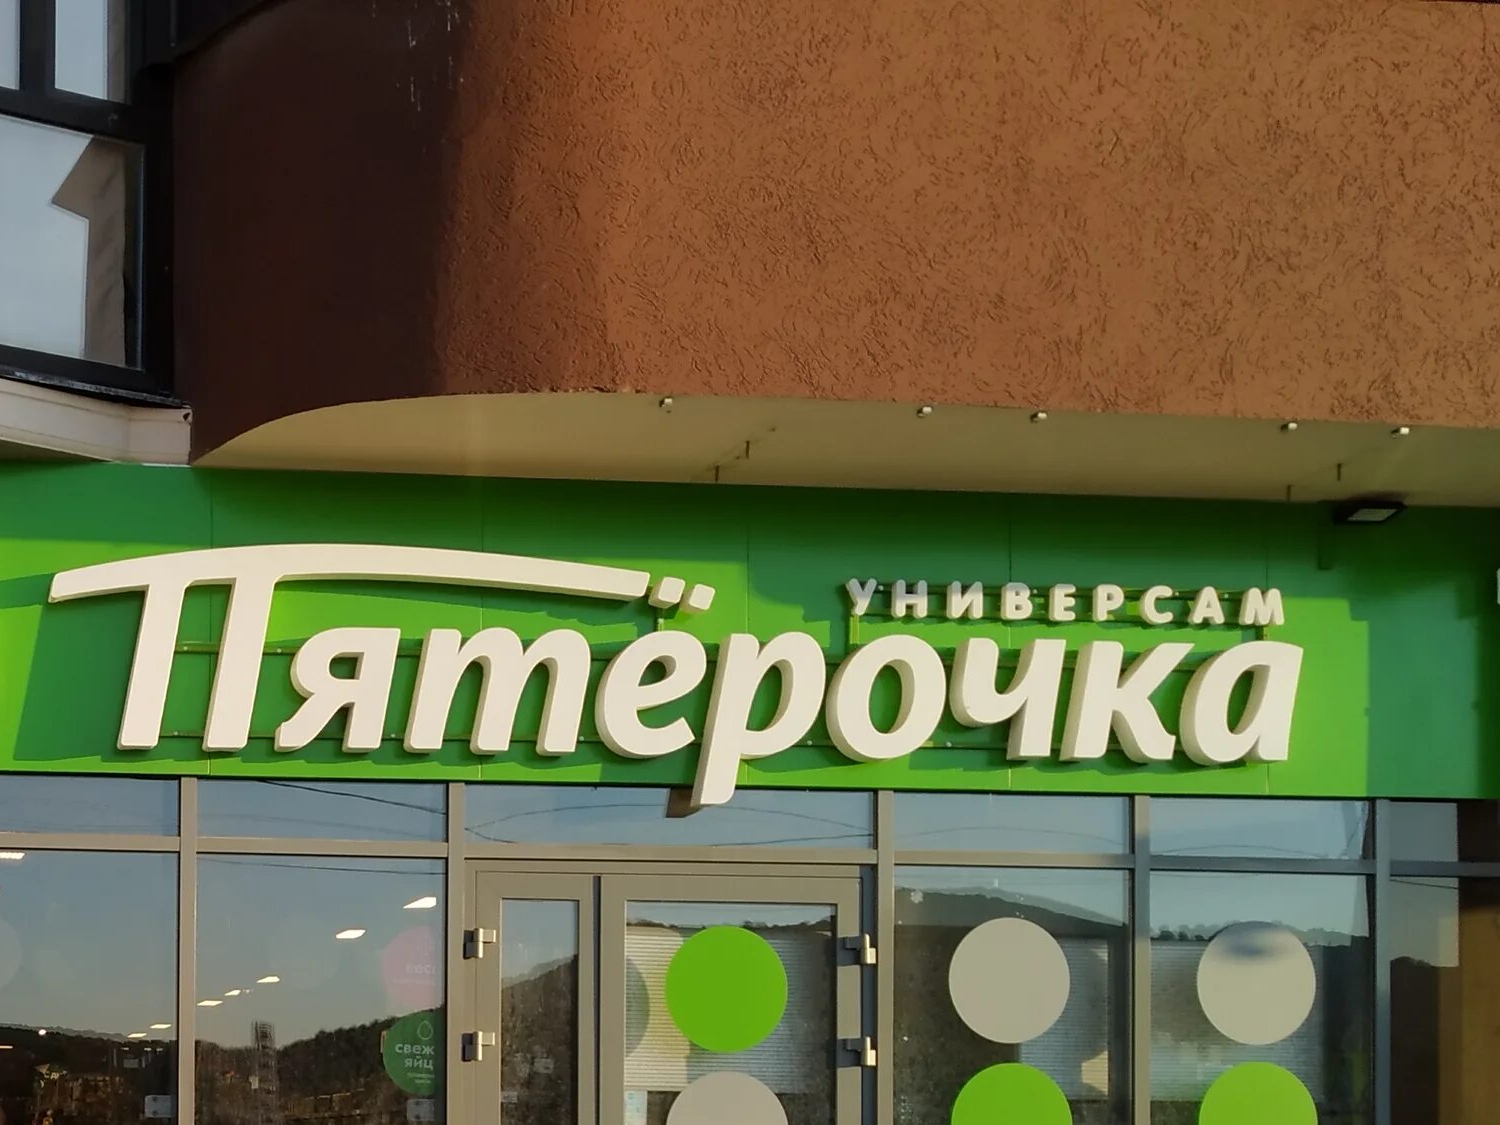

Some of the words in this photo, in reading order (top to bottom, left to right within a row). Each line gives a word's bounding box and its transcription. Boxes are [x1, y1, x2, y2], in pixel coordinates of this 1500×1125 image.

[845, 578, 1286, 626] УНИВЕРСАМ
[49, 543, 1304, 806] Пятёрочка
[394, 1043, 435, 1055] свеж
[404, 1055, 434, 1071] яйц
